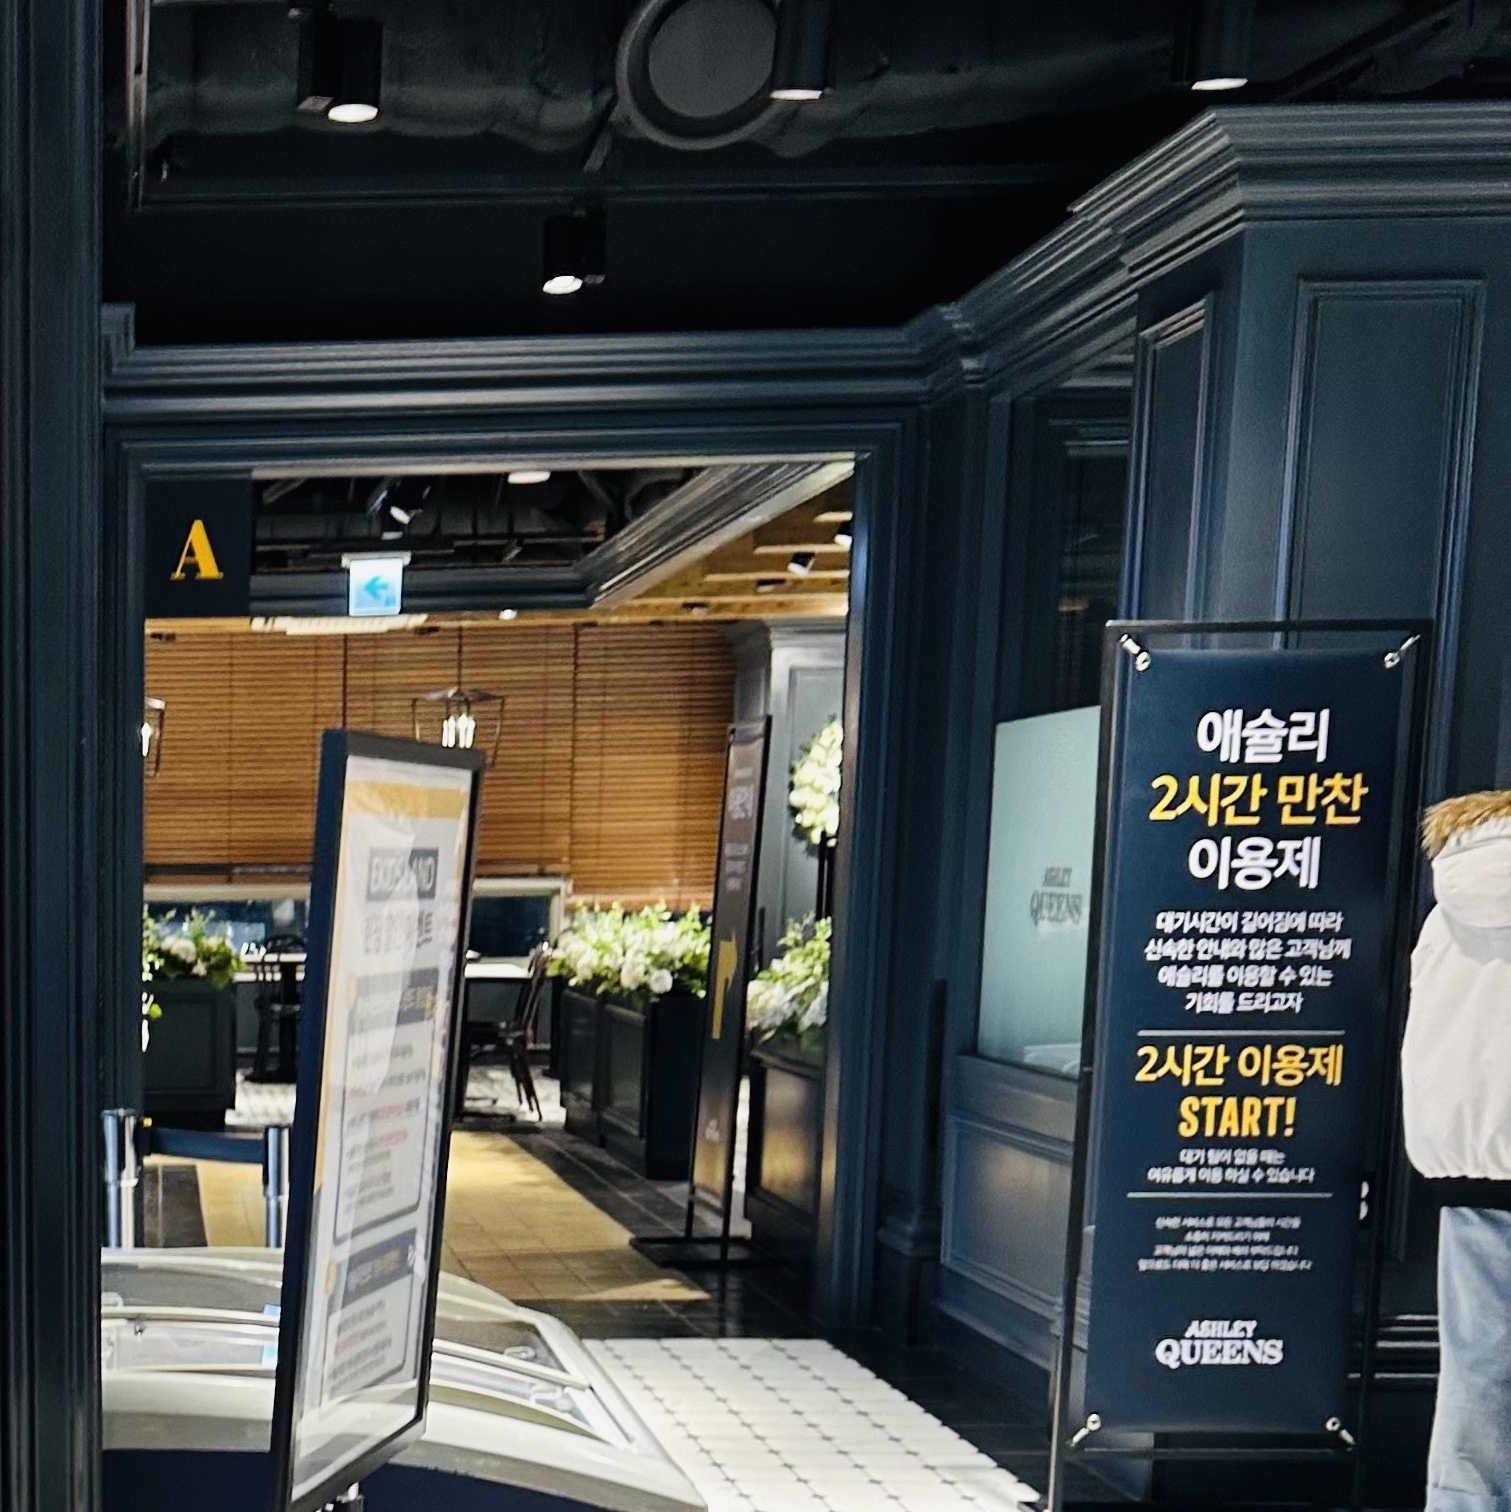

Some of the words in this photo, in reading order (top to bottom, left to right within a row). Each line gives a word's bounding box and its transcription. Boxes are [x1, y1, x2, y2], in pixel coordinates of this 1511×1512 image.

[169, 518, 224, 581] A
[1196, 708, 1330, 764] 애슐리
[1149, 773, 1268, 827] 2시간
[1276, 772, 1369, 826] 만찬
[1188, 836, 1322, 891] 이용제
[1156, 910, 1239, 933] 대기시간이
[1308, 911, 1344, 933] 따라
[1144, 938, 1195, 961] 신속한
[1284, 938, 1353, 960] 고객님께
[1157, 964, 1225, 988] 애슐리를
[1226, 964, 1278, 988] 이용할
[1278, 965, 1297, 987] 수
[1298, 965, 1334, 987] 있는
[1184, 991, 1236, 1014] 기회를
[1236, 991, 1304, 1014] 드리고자
[1135, 1044, 1230, 1088] 2시간
[1238, 1043, 1344, 1086] 이용제
[1178, 1096, 1298, 1138] START!
[1184, 1319, 1257, 1338] ASHLEY
[1155, 1338, 1284, 1370] QUEENS
